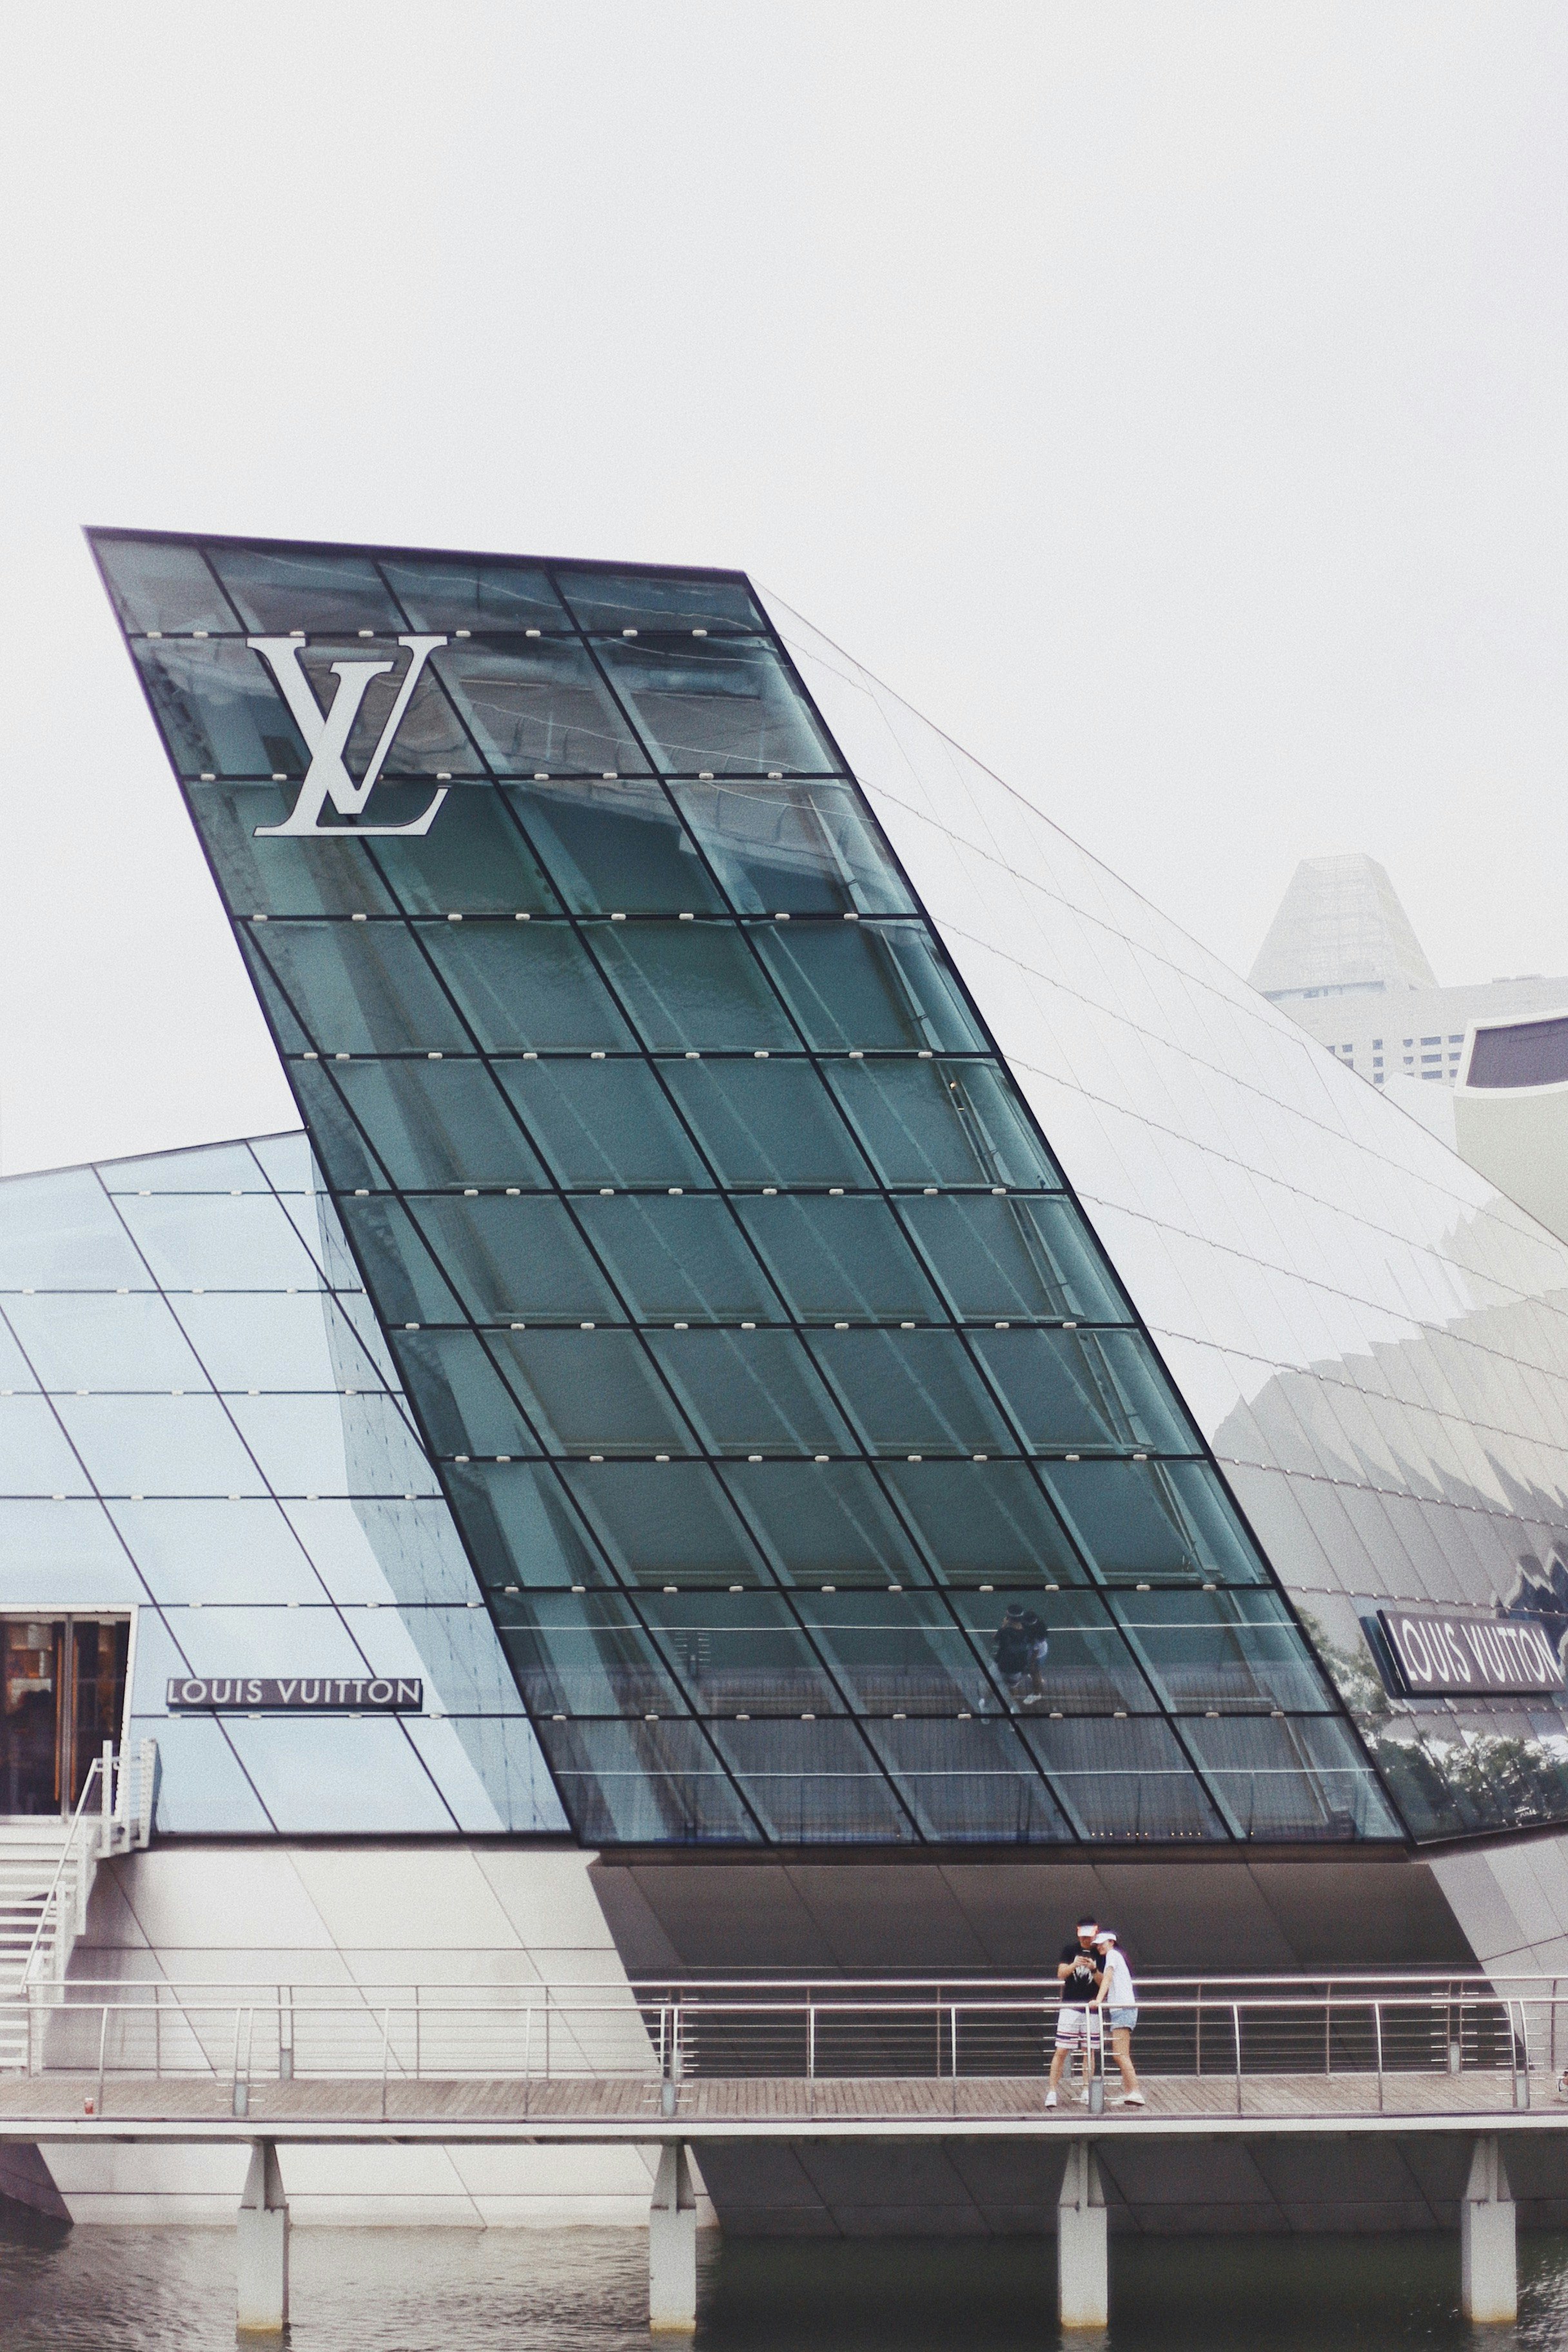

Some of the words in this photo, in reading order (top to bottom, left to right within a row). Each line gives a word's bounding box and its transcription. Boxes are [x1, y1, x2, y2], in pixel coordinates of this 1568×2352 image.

[1387, 1618, 1471, 1683] LOUIS
[1460, 1623, 1563, 1684] VUITTON
[167, 1680, 262, 1703] LOUIS
[277, 1680, 420, 1703] VUITTON
